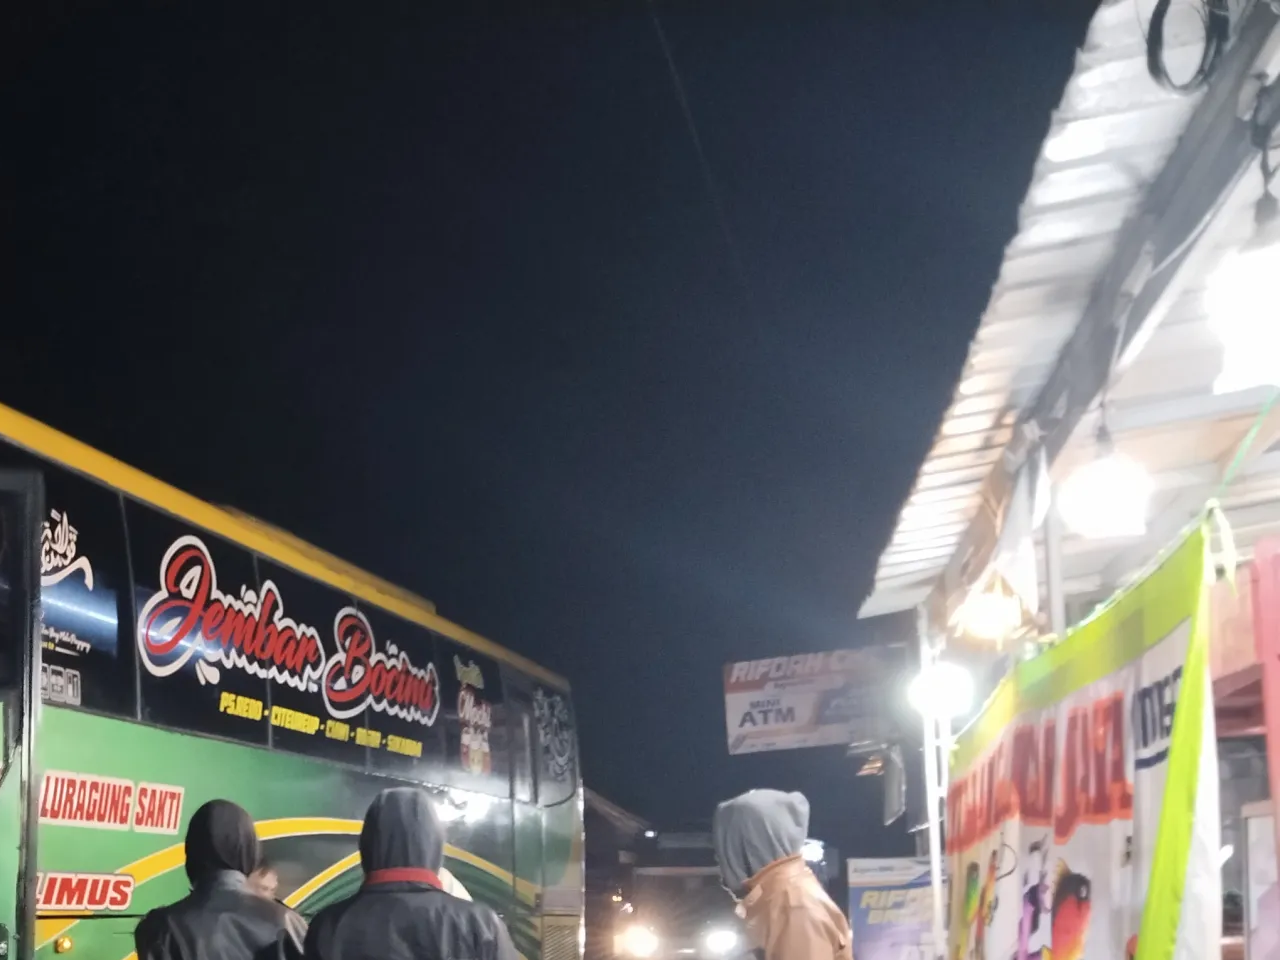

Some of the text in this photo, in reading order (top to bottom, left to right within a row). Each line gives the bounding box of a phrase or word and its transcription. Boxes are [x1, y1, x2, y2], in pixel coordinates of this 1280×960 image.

[143, 544, 322, 678] Jembar
[325, 612, 437, 712] Bocimi
[738, 706, 796, 729] ATM
[40, 775, 133, 826] LURAGUNG
[135, 786, 182, 831] SAKTI
[36, 876, 132, 906] IMUS
